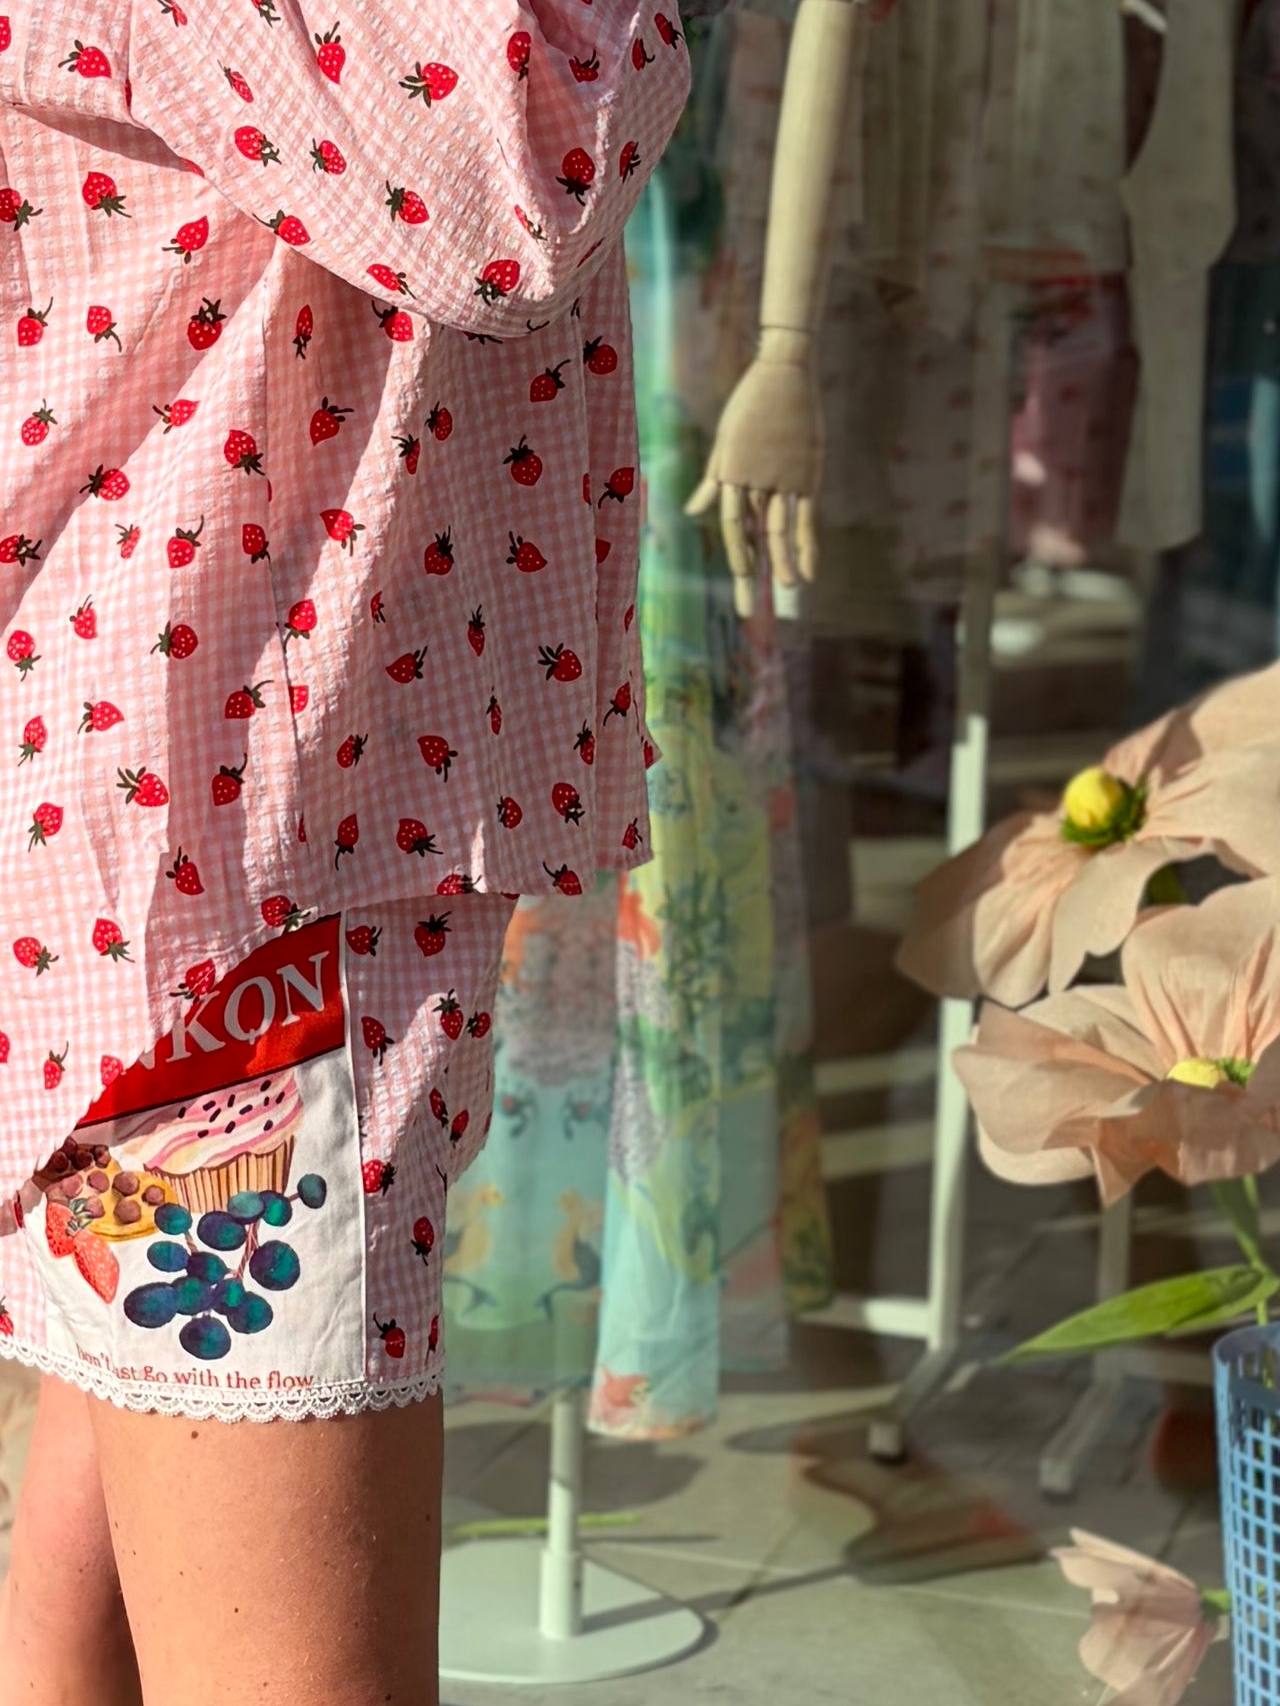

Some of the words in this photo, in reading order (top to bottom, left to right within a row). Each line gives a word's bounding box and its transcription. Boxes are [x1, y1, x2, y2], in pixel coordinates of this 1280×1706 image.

[143, 1365, 168, 1383] go
[174, 1367, 219, 1388] with
[226, 1371, 261, 1390] the
[266, 1370, 314, 1390] flow
